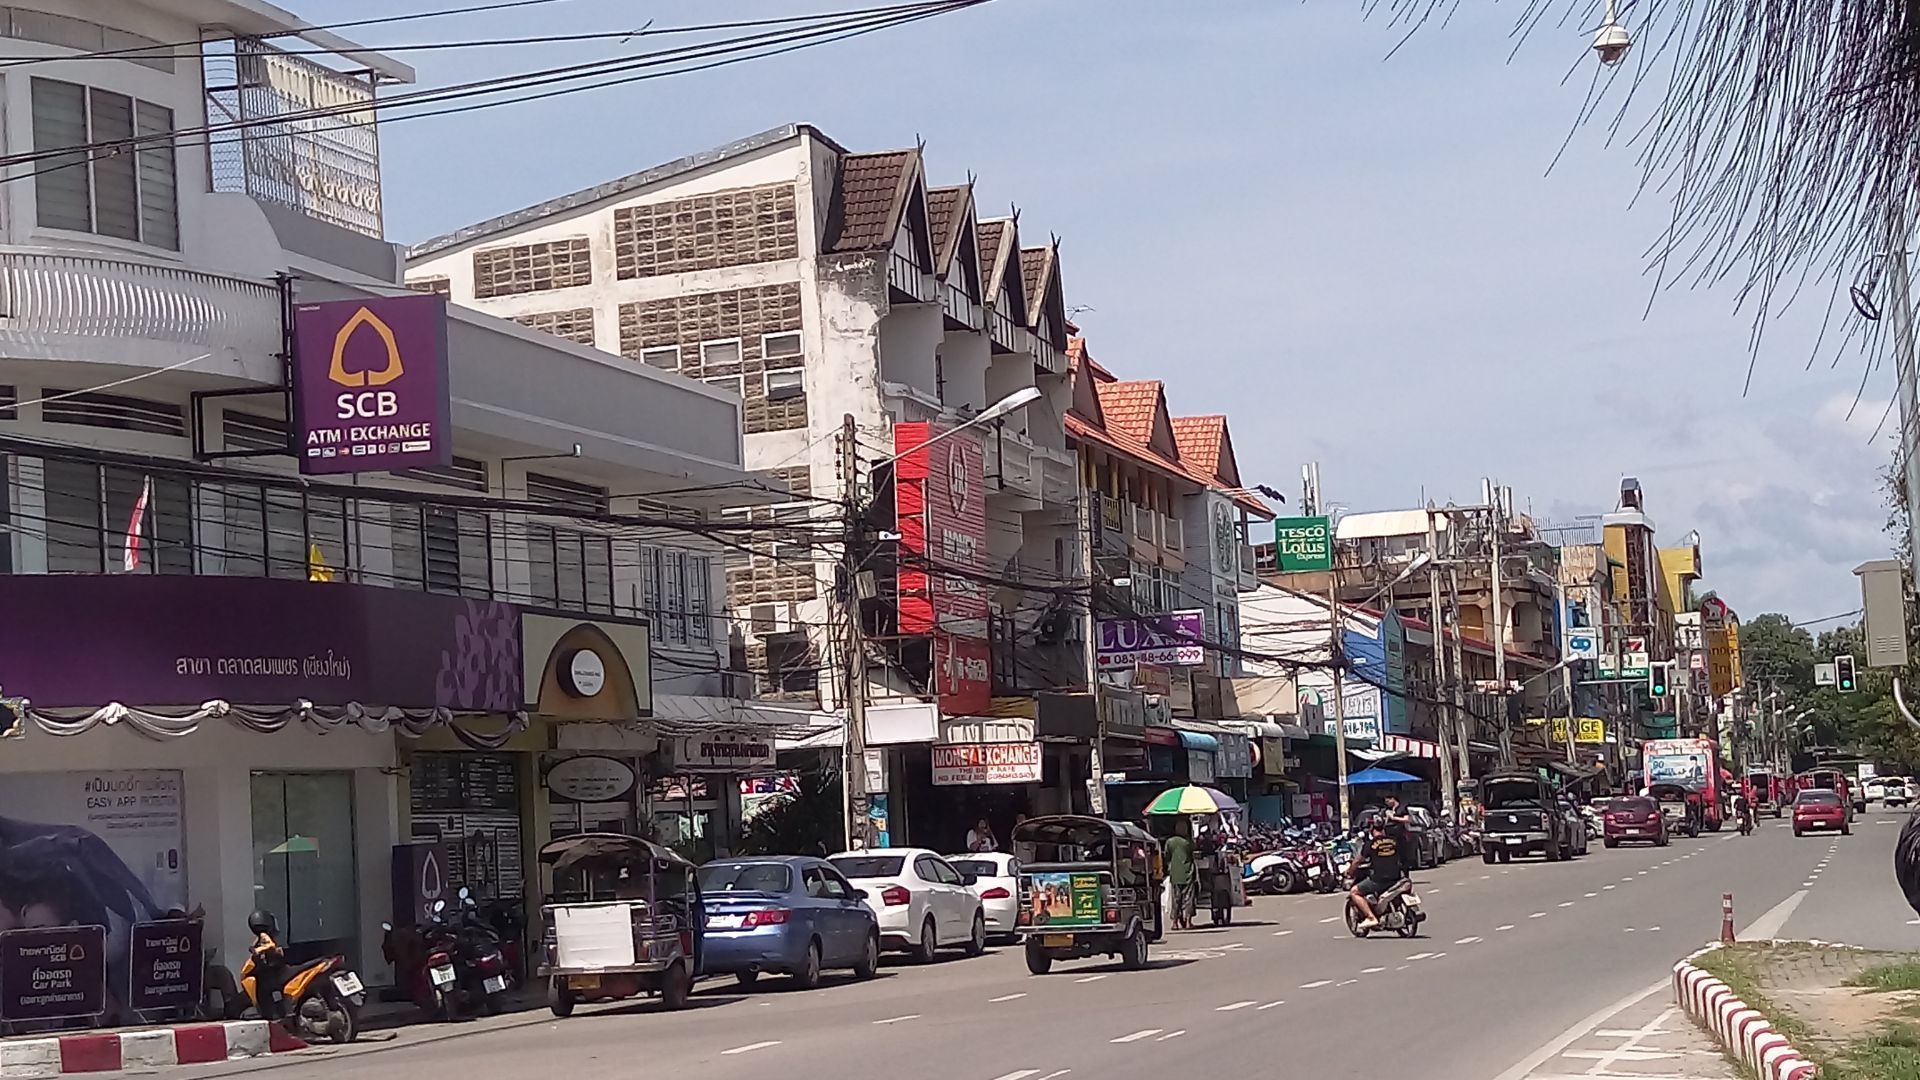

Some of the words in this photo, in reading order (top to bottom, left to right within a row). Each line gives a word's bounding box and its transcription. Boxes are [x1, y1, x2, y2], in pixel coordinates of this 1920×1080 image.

[337, 391, 399, 419] SCB
[307, 428, 341, 445] ATM
[351, 422, 431, 442] EXCHANGE
[1280, 526, 1325, 538] TESCO
[1282, 540, 1326, 555] Lotus
[1114, 649, 1201, 665] 083-88-66-999
[176, 656, 211, 676] สาขา
[217, 657, 299, 676] ตลาดสมเพชร
[936, 748, 976, 767] MONEY
[978, 746, 1038, 766] EXCHANGE
[87, 796, 112, 809] EASY
[117, 795, 137, 808] APP
[50, 954, 67, 962] SCB
[32, 980, 49, 990] Car
[51, 979, 72, 989] Park
